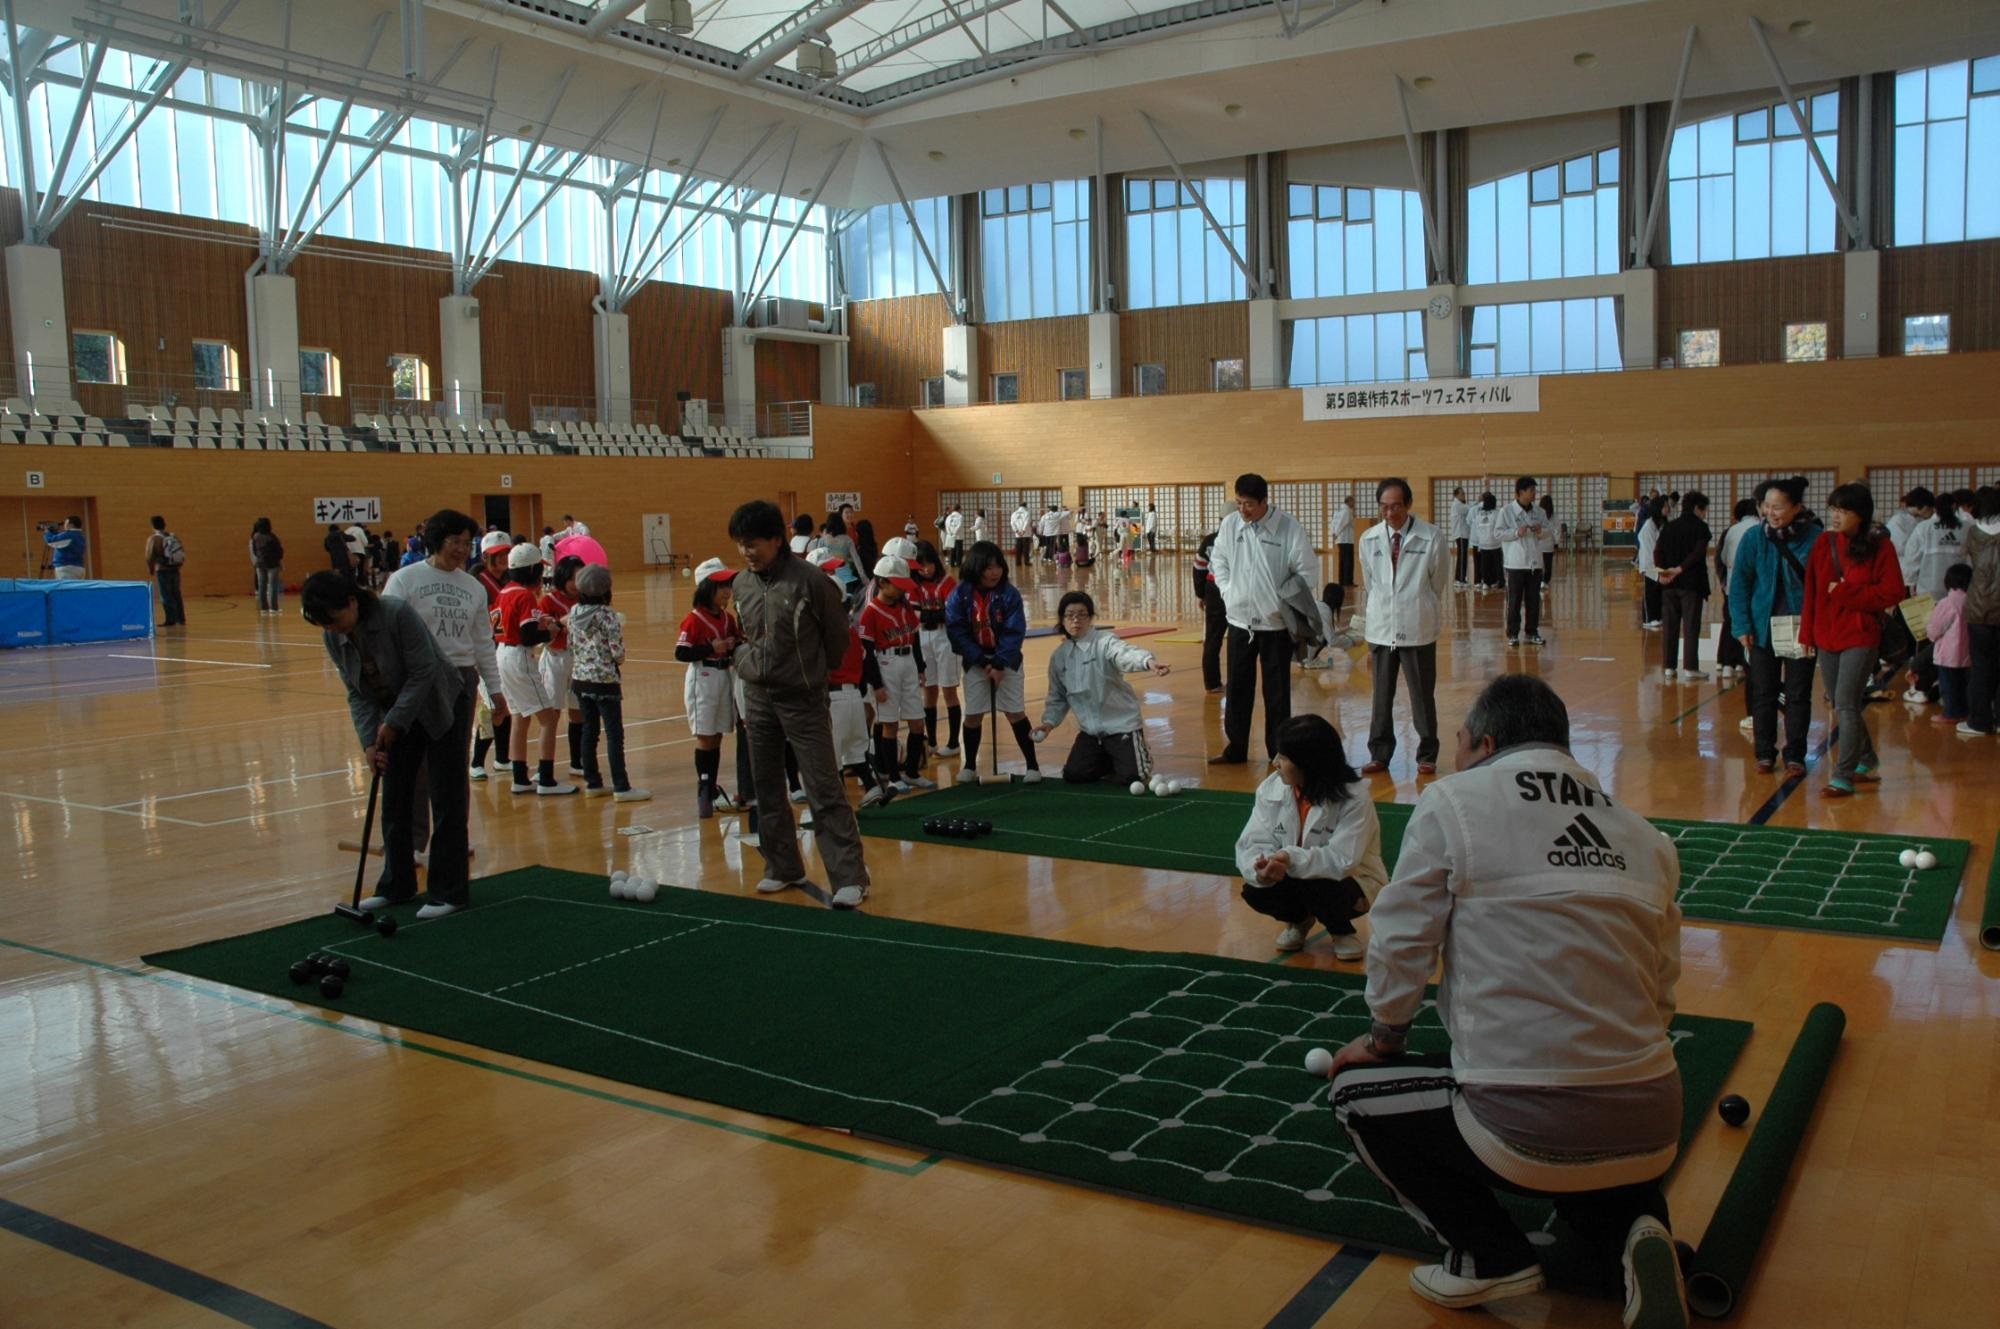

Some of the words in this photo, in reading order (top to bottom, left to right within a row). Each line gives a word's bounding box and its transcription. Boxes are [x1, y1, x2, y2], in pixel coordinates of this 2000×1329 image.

[1326, 386, 1512, 410] 第5回美作市スポーツフェスティバル
[30, 474, 41, 485] B
[317, 500, 379, 521] キンボール
[432, 606, 469, 620] TRACK
[1547, 846, 1627, 871] adidas
